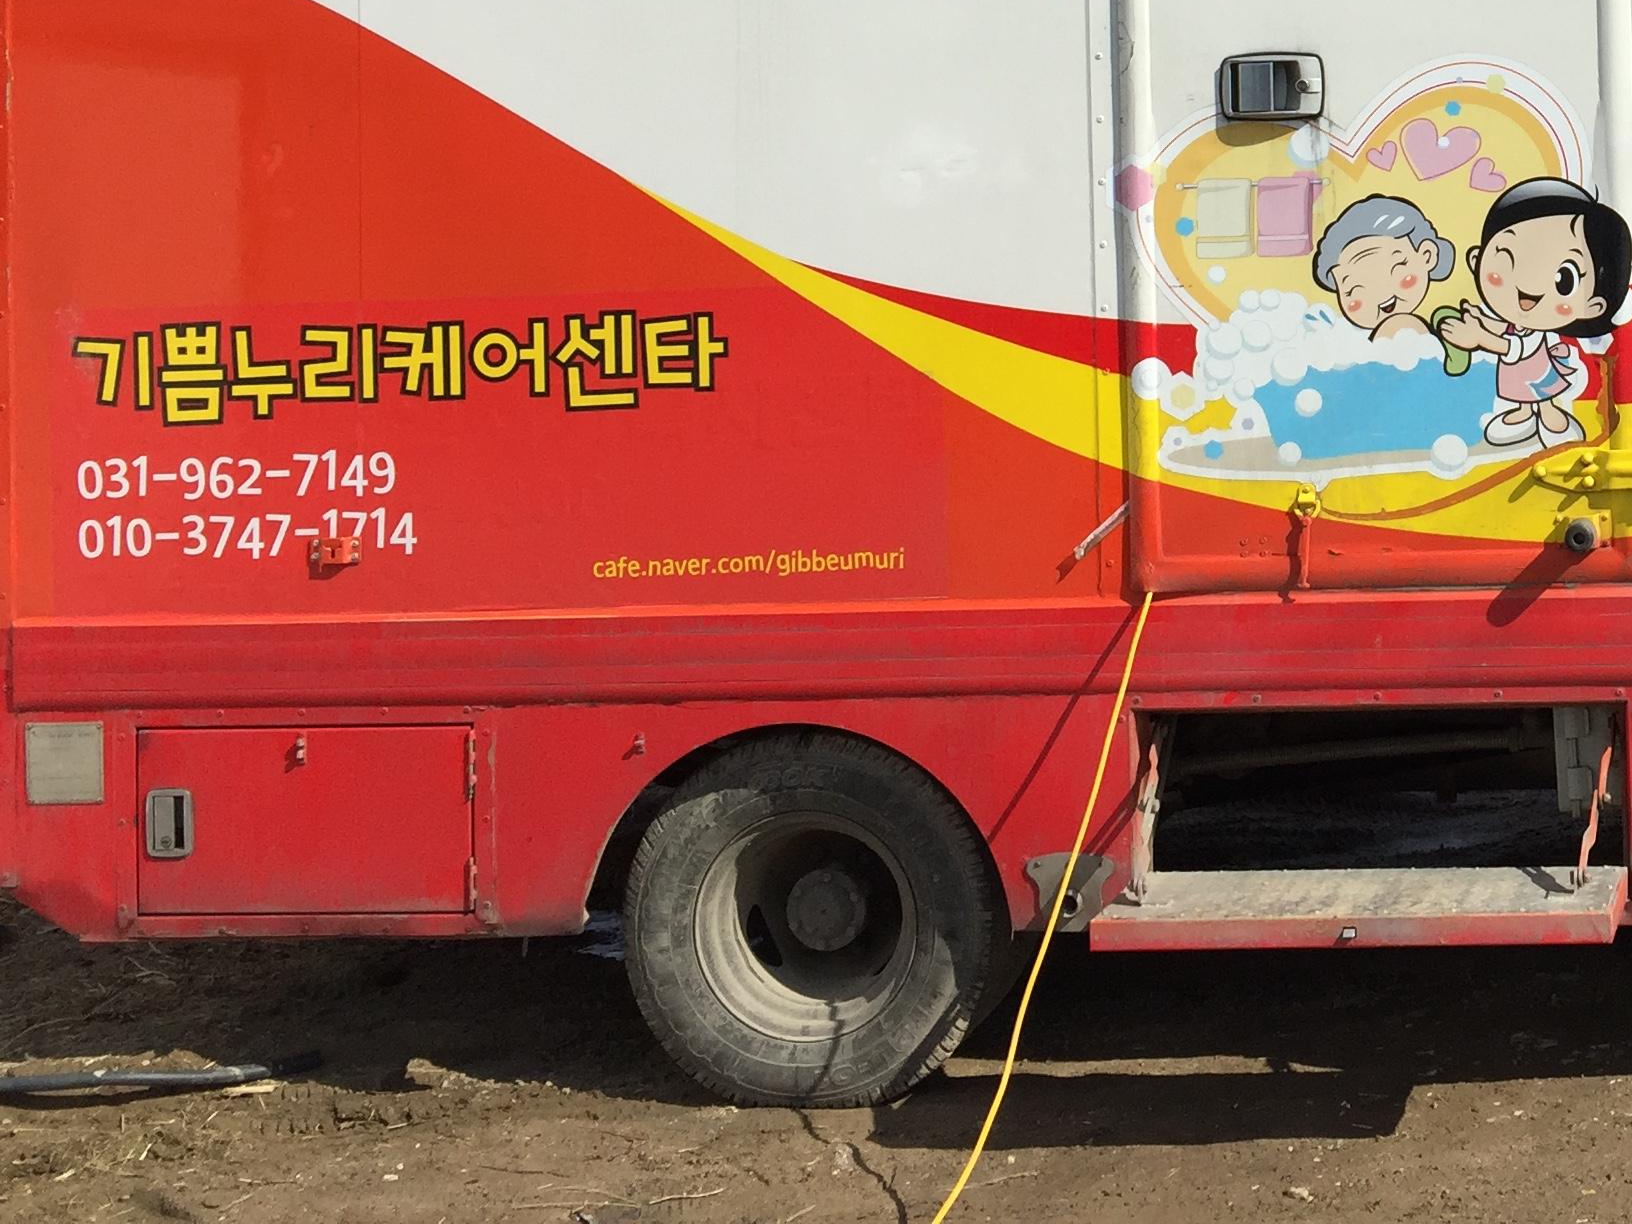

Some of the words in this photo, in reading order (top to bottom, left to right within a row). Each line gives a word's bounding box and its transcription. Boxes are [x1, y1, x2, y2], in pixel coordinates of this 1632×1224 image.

[71, 309, 729, 428] 기쁨누리케어센타
[77, 449, 397, 501] 031-962-7149
[78, 507, 418, 560] 010-3747-1714
[592, 547, 906, 579] cafe.naver.com/gibbeumuri
